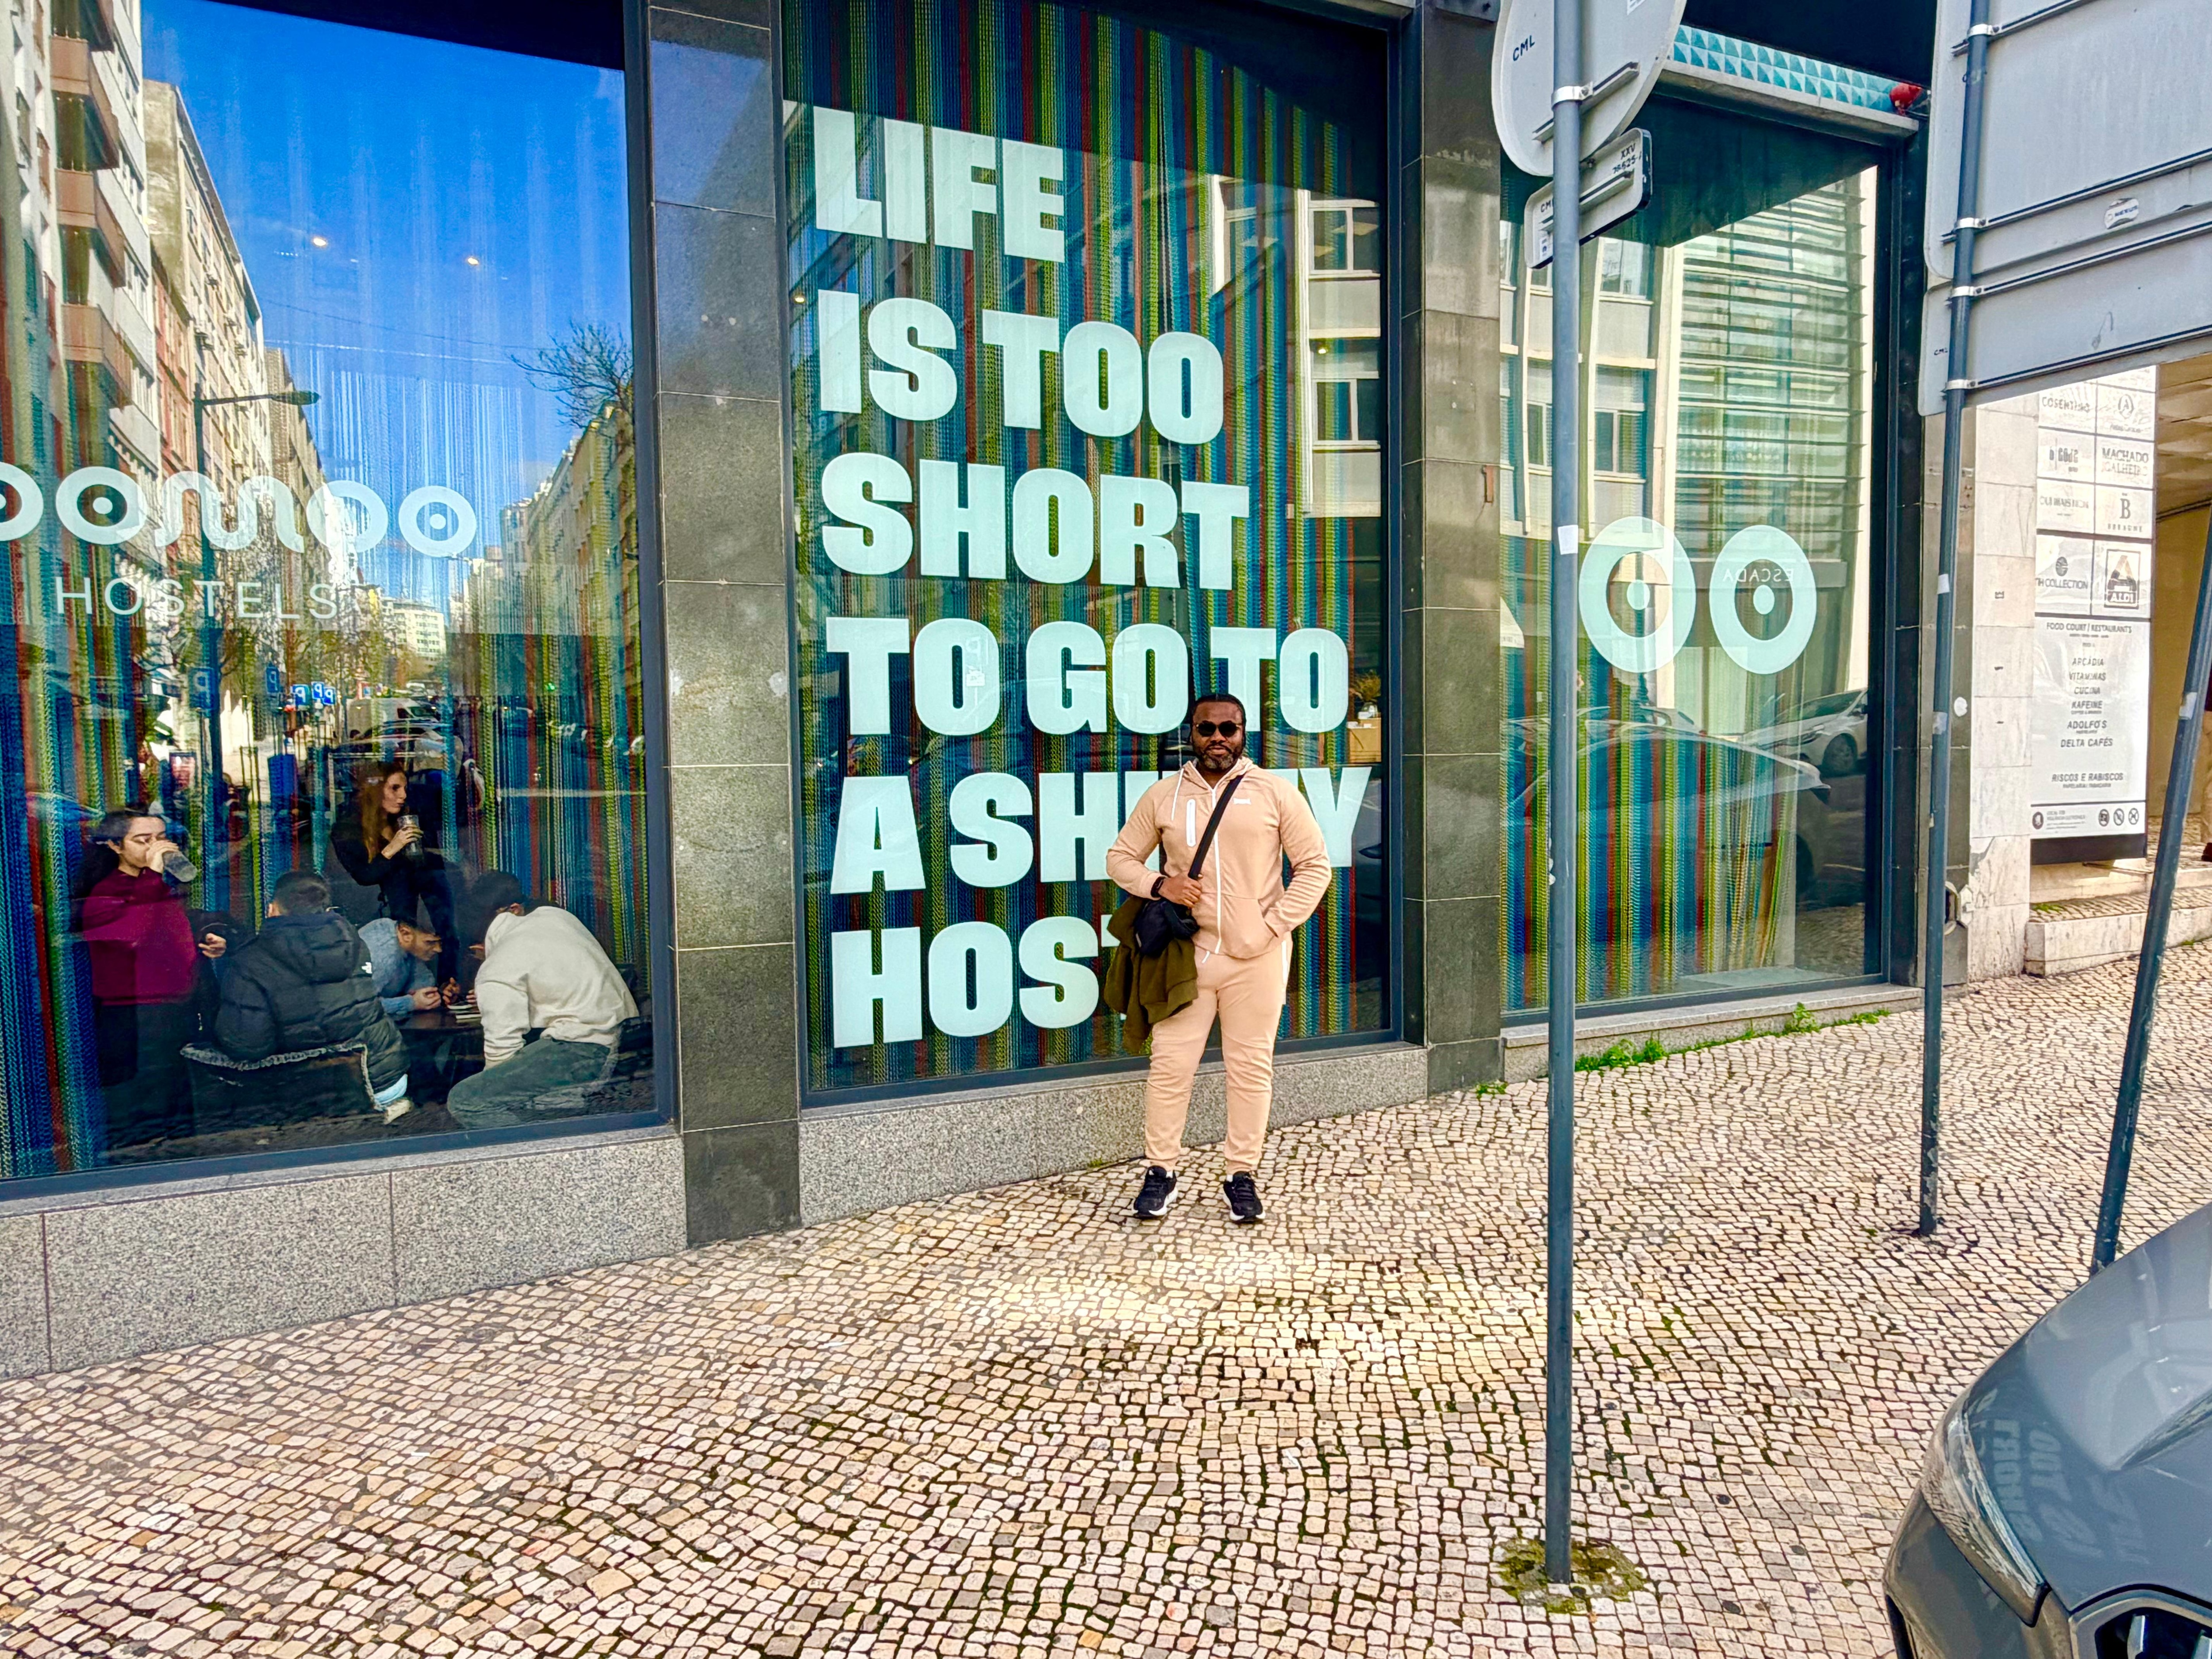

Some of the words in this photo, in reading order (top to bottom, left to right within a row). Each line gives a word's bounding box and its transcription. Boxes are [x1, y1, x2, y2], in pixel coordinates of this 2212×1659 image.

[1513, 35, 1535, 61] CML
[814, 105, 1064, 263] LIFE
[1540, 200, 1553, 213] CM
[818, 289, 957, 422] IS
[982, 309, 1224, 445] TOO
[821, 452, 1249, 591] SHORT
[55, 576, 338, 619] HOSTELS
[2045, 578, 2088, 589] COLLECTION
[2109, 592, 2134, 603] ALDI
[2046, 622, 2064, 630] FOOD
[2066, 623, 2087, 631] COURT
[826, 617, 1000, 736] TO
[1025, 621, 1189, 734] GO
[1210, 627, 1349, 733] TO
[2060, 738, 2085, 748] DELTA
[2051, 773, 2079, 782] RISCOS
[2088, 772, 2124, 782] RABISCOS
[830, 775, 926, 895] A
[949, 767, 1373, 888] SHY
[831, 913, 1113, 1049] HOS
